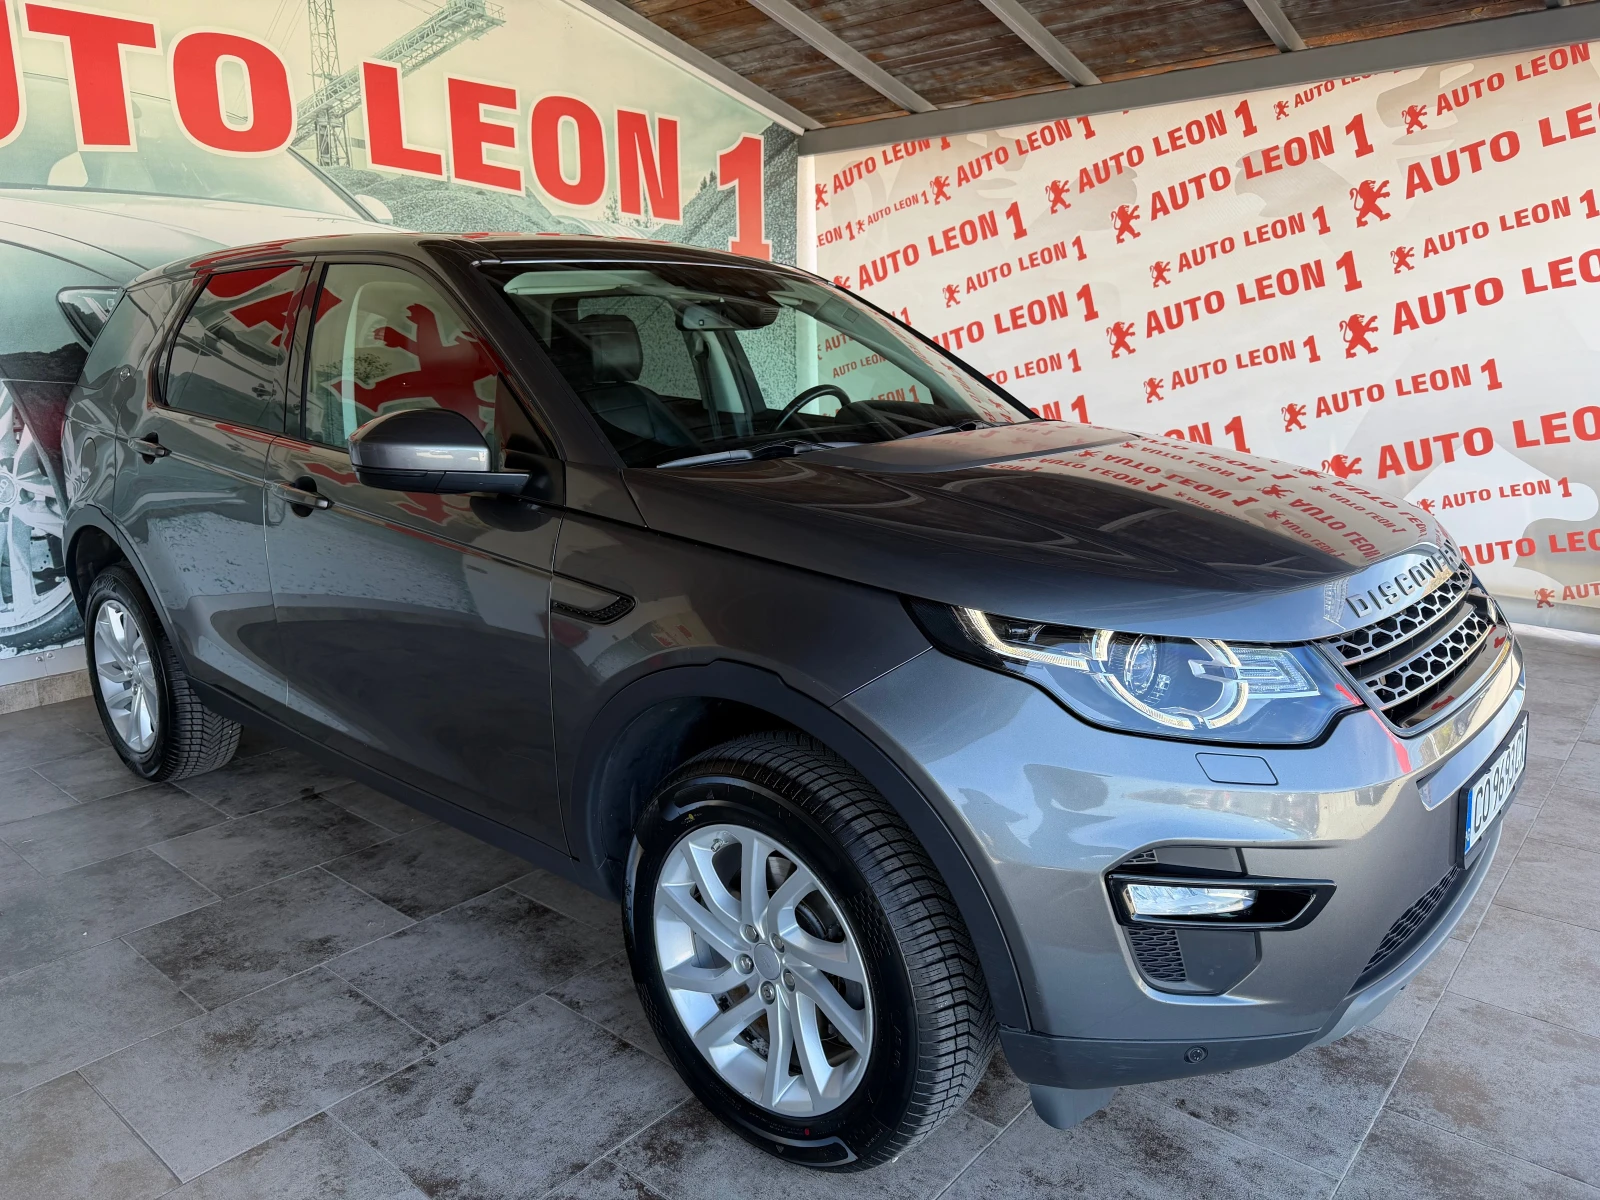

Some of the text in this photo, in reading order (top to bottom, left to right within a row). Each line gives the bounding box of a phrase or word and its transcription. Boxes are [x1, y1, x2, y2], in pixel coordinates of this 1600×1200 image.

[1294, 80, 1335, 108] AUTO
[1437, 43, 1590, 116] AUTO LEON
[363, 62, 680, 221] LEON
[718, 135, 772, 260] 1
[833, 156, 877, 194] AUTO
[882, 138, 931, 165] LEON
[957, 116, 1096, 187] AUTO LEON 1
[1078, 100, 1258, 193] AUTO LEON 1
[1150, 114, 1374, 221] AUTO LEON 1
[1406, 103, 1600, 199] AUTO LE
[816, 221, 855, 247] EON 1
[867, 190, 929, 225] AUTO LEON 1
[1424, 189, 1600, 258] AUTO LEON 1
[859, 202, 1027, 290] AUTO LEON 1
[966, 236, 1087, 294] AUTO LEON 1
[1179, 206, 1331, 272] AUTO LEON 1
[994, 292, 1068, 334] LEON
[1076, 284, 1099, 322] 1
[1146, 251, 1362, 338] AUTO LEON 1
[1393, 278, 1504, 335] AUTO
[833, 361, 857, 378] AUTO
[1014, 353, 1062, 379] LEON
[1068, 348, 1081, 372] 1
[1172, 336, 1320, 390] AUTO LEON 1
[1316, 359, 1502, 418] AUTO LEON 1
[909, 385, 919, 402] 1
[1071, 395, 1091, 424] 1
[1224, 416, 1250, 454] 1
[1378, 427, 1494, 479] AUTO
[1442, 477, 1572, 509] AUTO LEON 1
[1459, 537, 1536, 566] AUTO
[1473, 777, 1490, 834] CO
